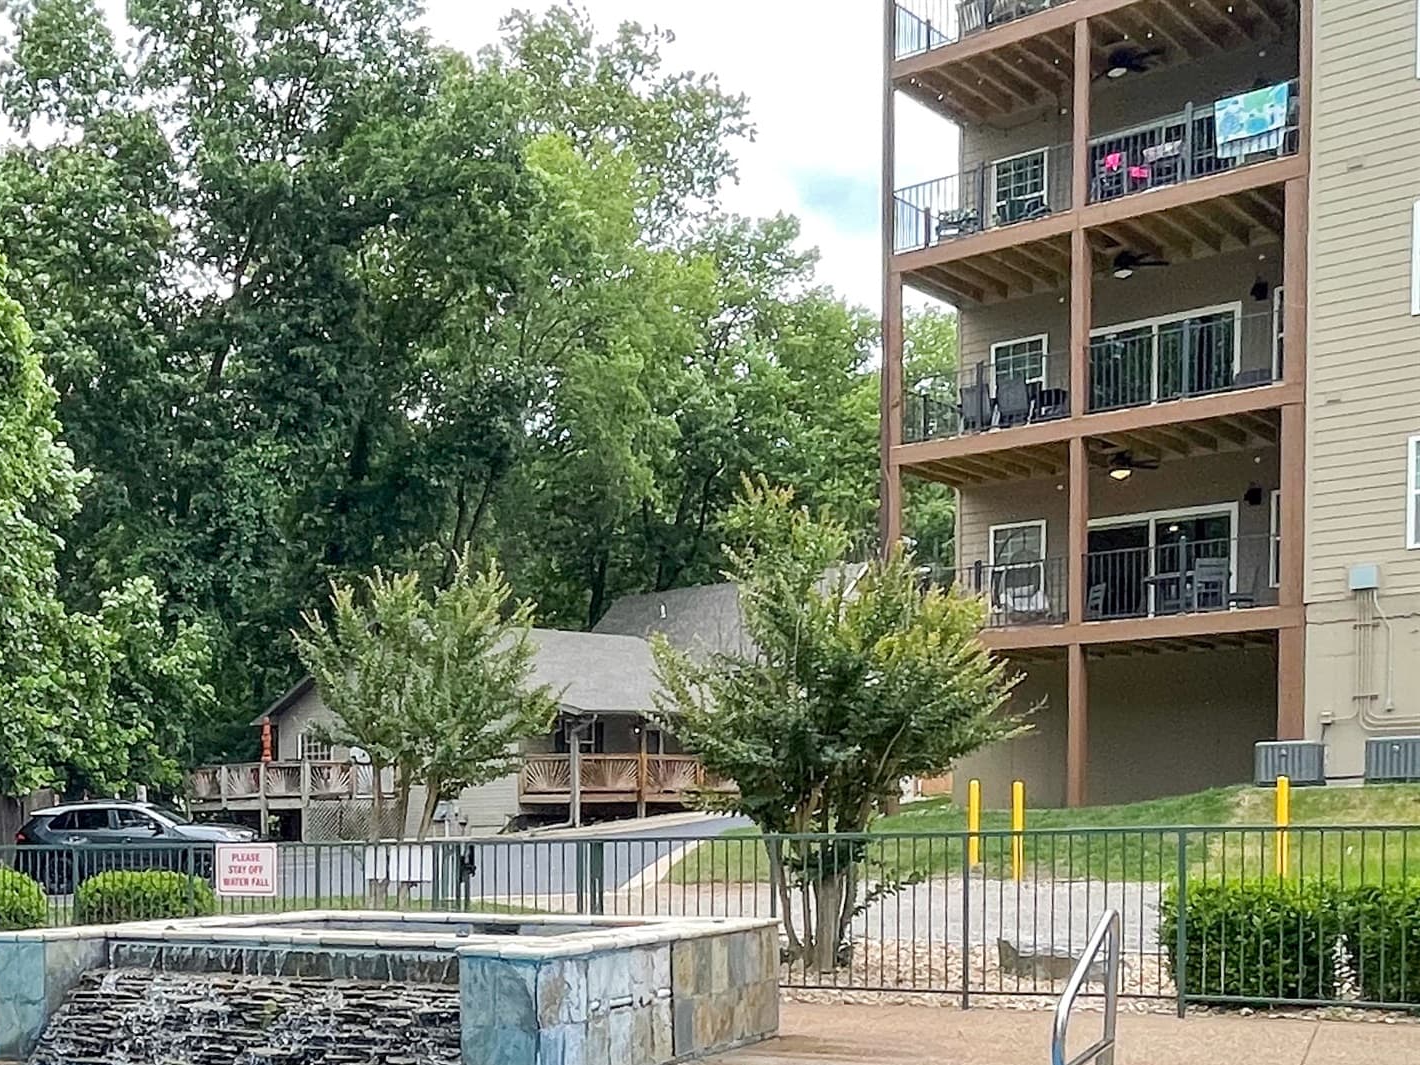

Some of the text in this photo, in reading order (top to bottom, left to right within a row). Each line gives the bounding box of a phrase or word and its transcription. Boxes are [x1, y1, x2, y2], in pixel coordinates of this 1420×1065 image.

[231, 853, 260, 862] PLEASE
[228, 865, 263, 874] STAY OFF
[223, 878, 269, 887] WATER FALL
